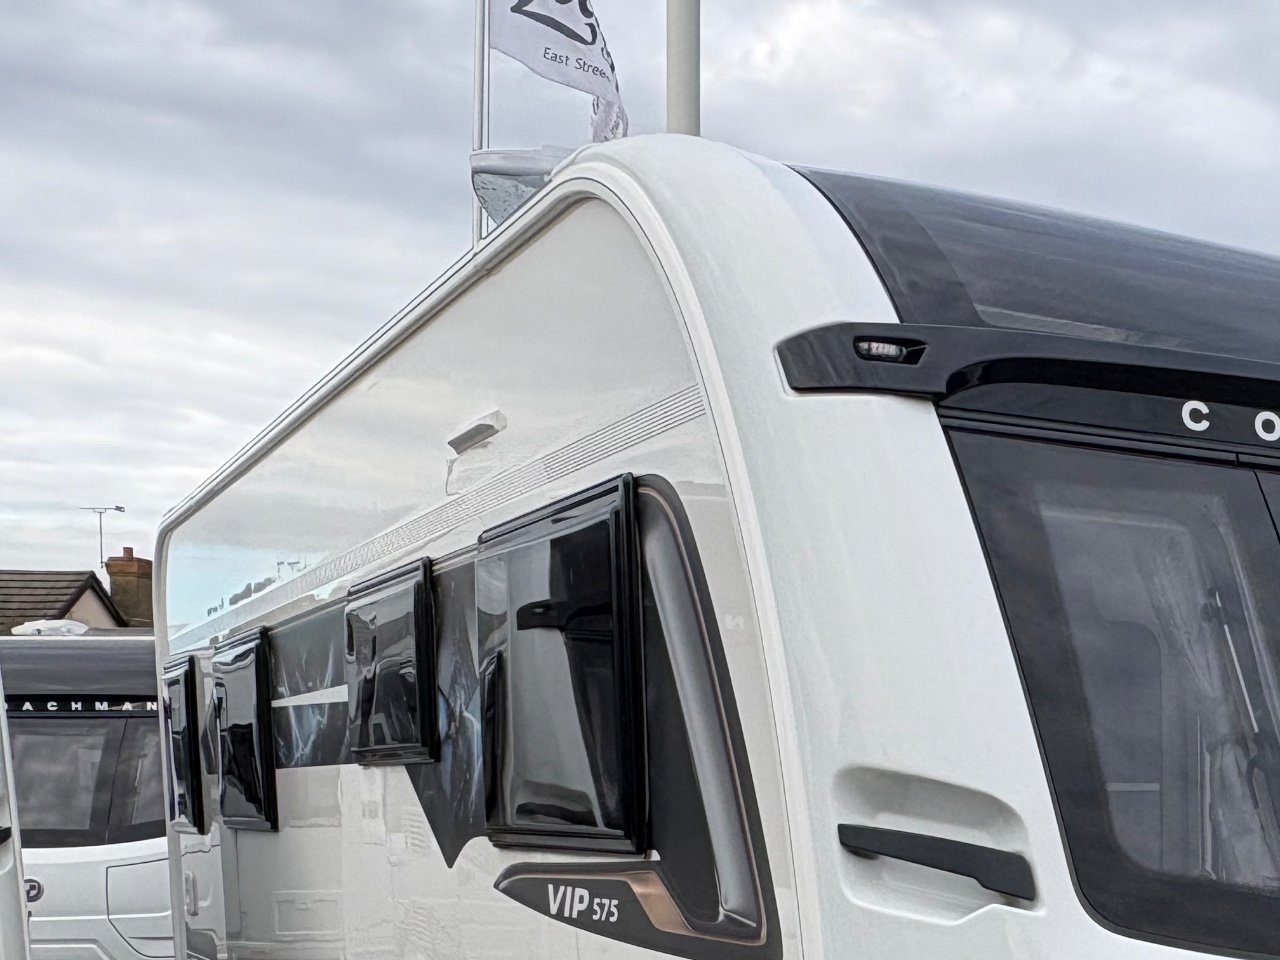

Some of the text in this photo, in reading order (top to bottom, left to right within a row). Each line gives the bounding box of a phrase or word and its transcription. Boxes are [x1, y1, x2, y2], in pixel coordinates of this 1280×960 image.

[543, 46, 570, 66] East
[4, 701, 157, 711] ACHMAN
[547, 883, 619, 923] VIP 575
